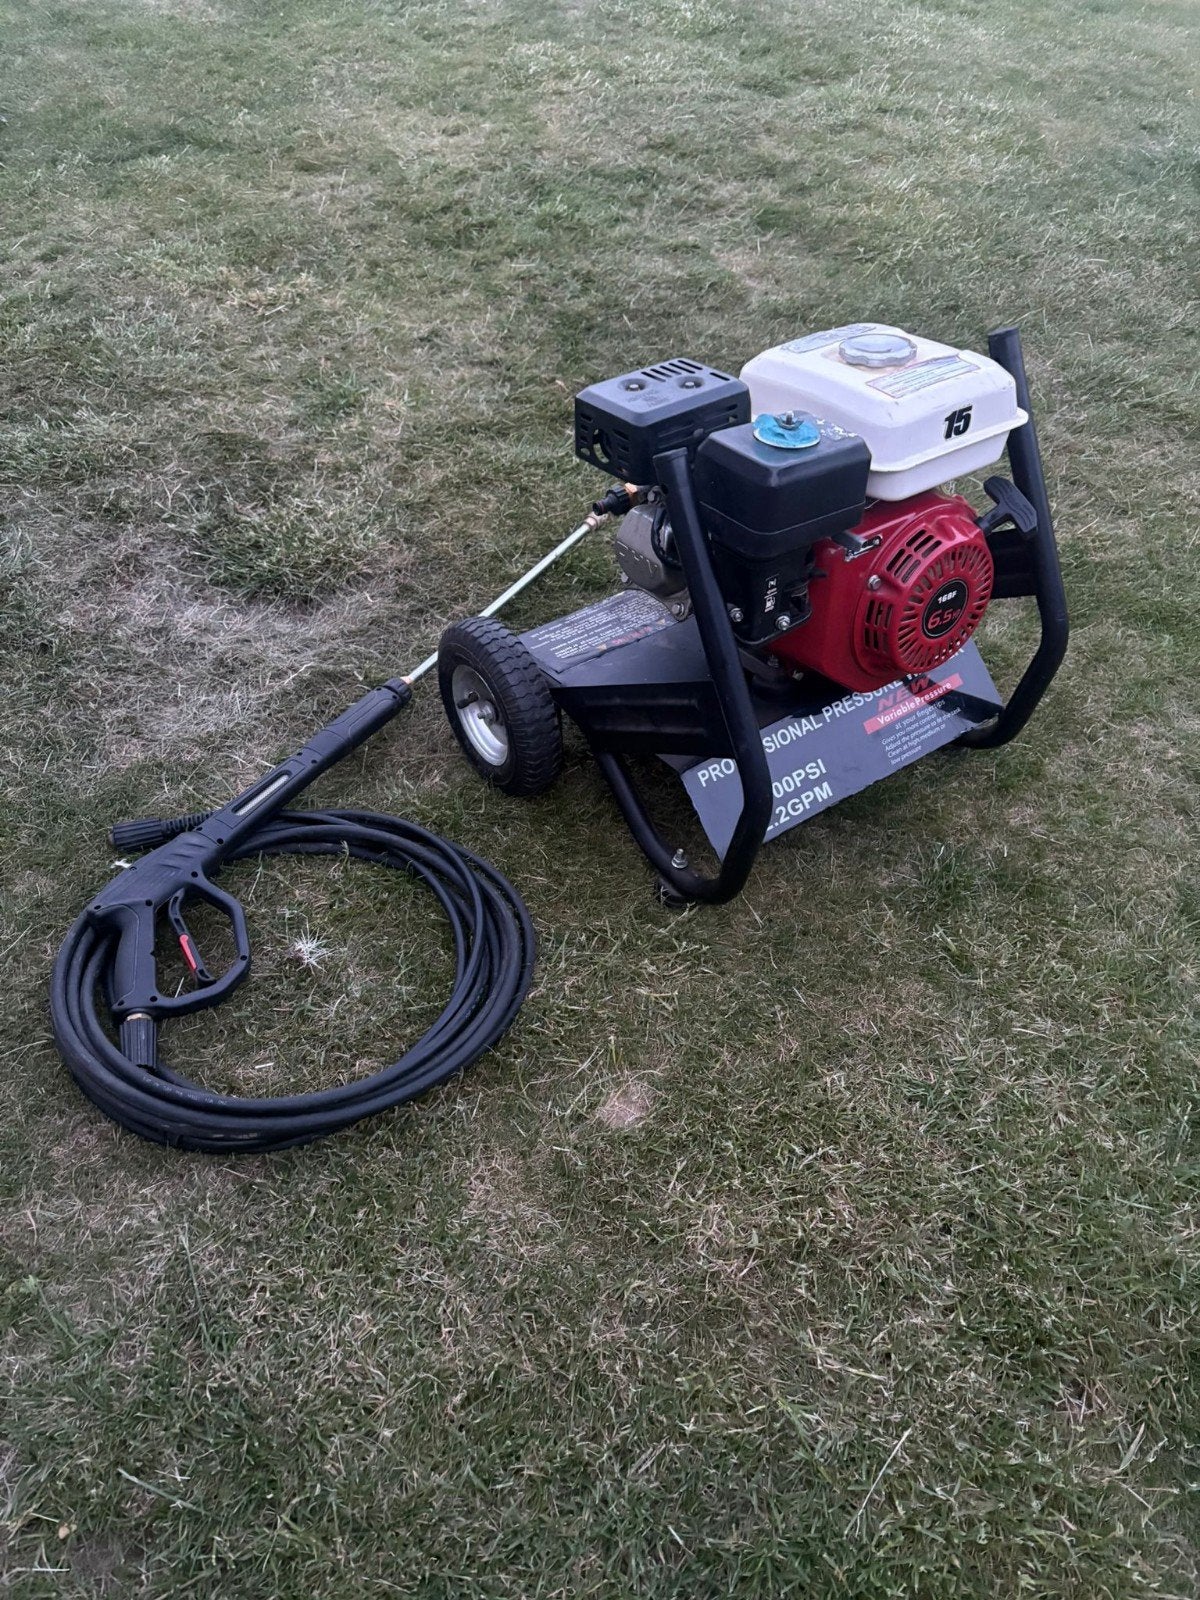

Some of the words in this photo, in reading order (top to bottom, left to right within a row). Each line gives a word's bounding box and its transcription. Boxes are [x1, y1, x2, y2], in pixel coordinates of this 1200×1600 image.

[943, 405, 973, 440] 15
[878, 676, 929, 712] NEW
[697, 714, 823, 788] PROSIONAL
[772, 758, 827, 798] 00PSI
